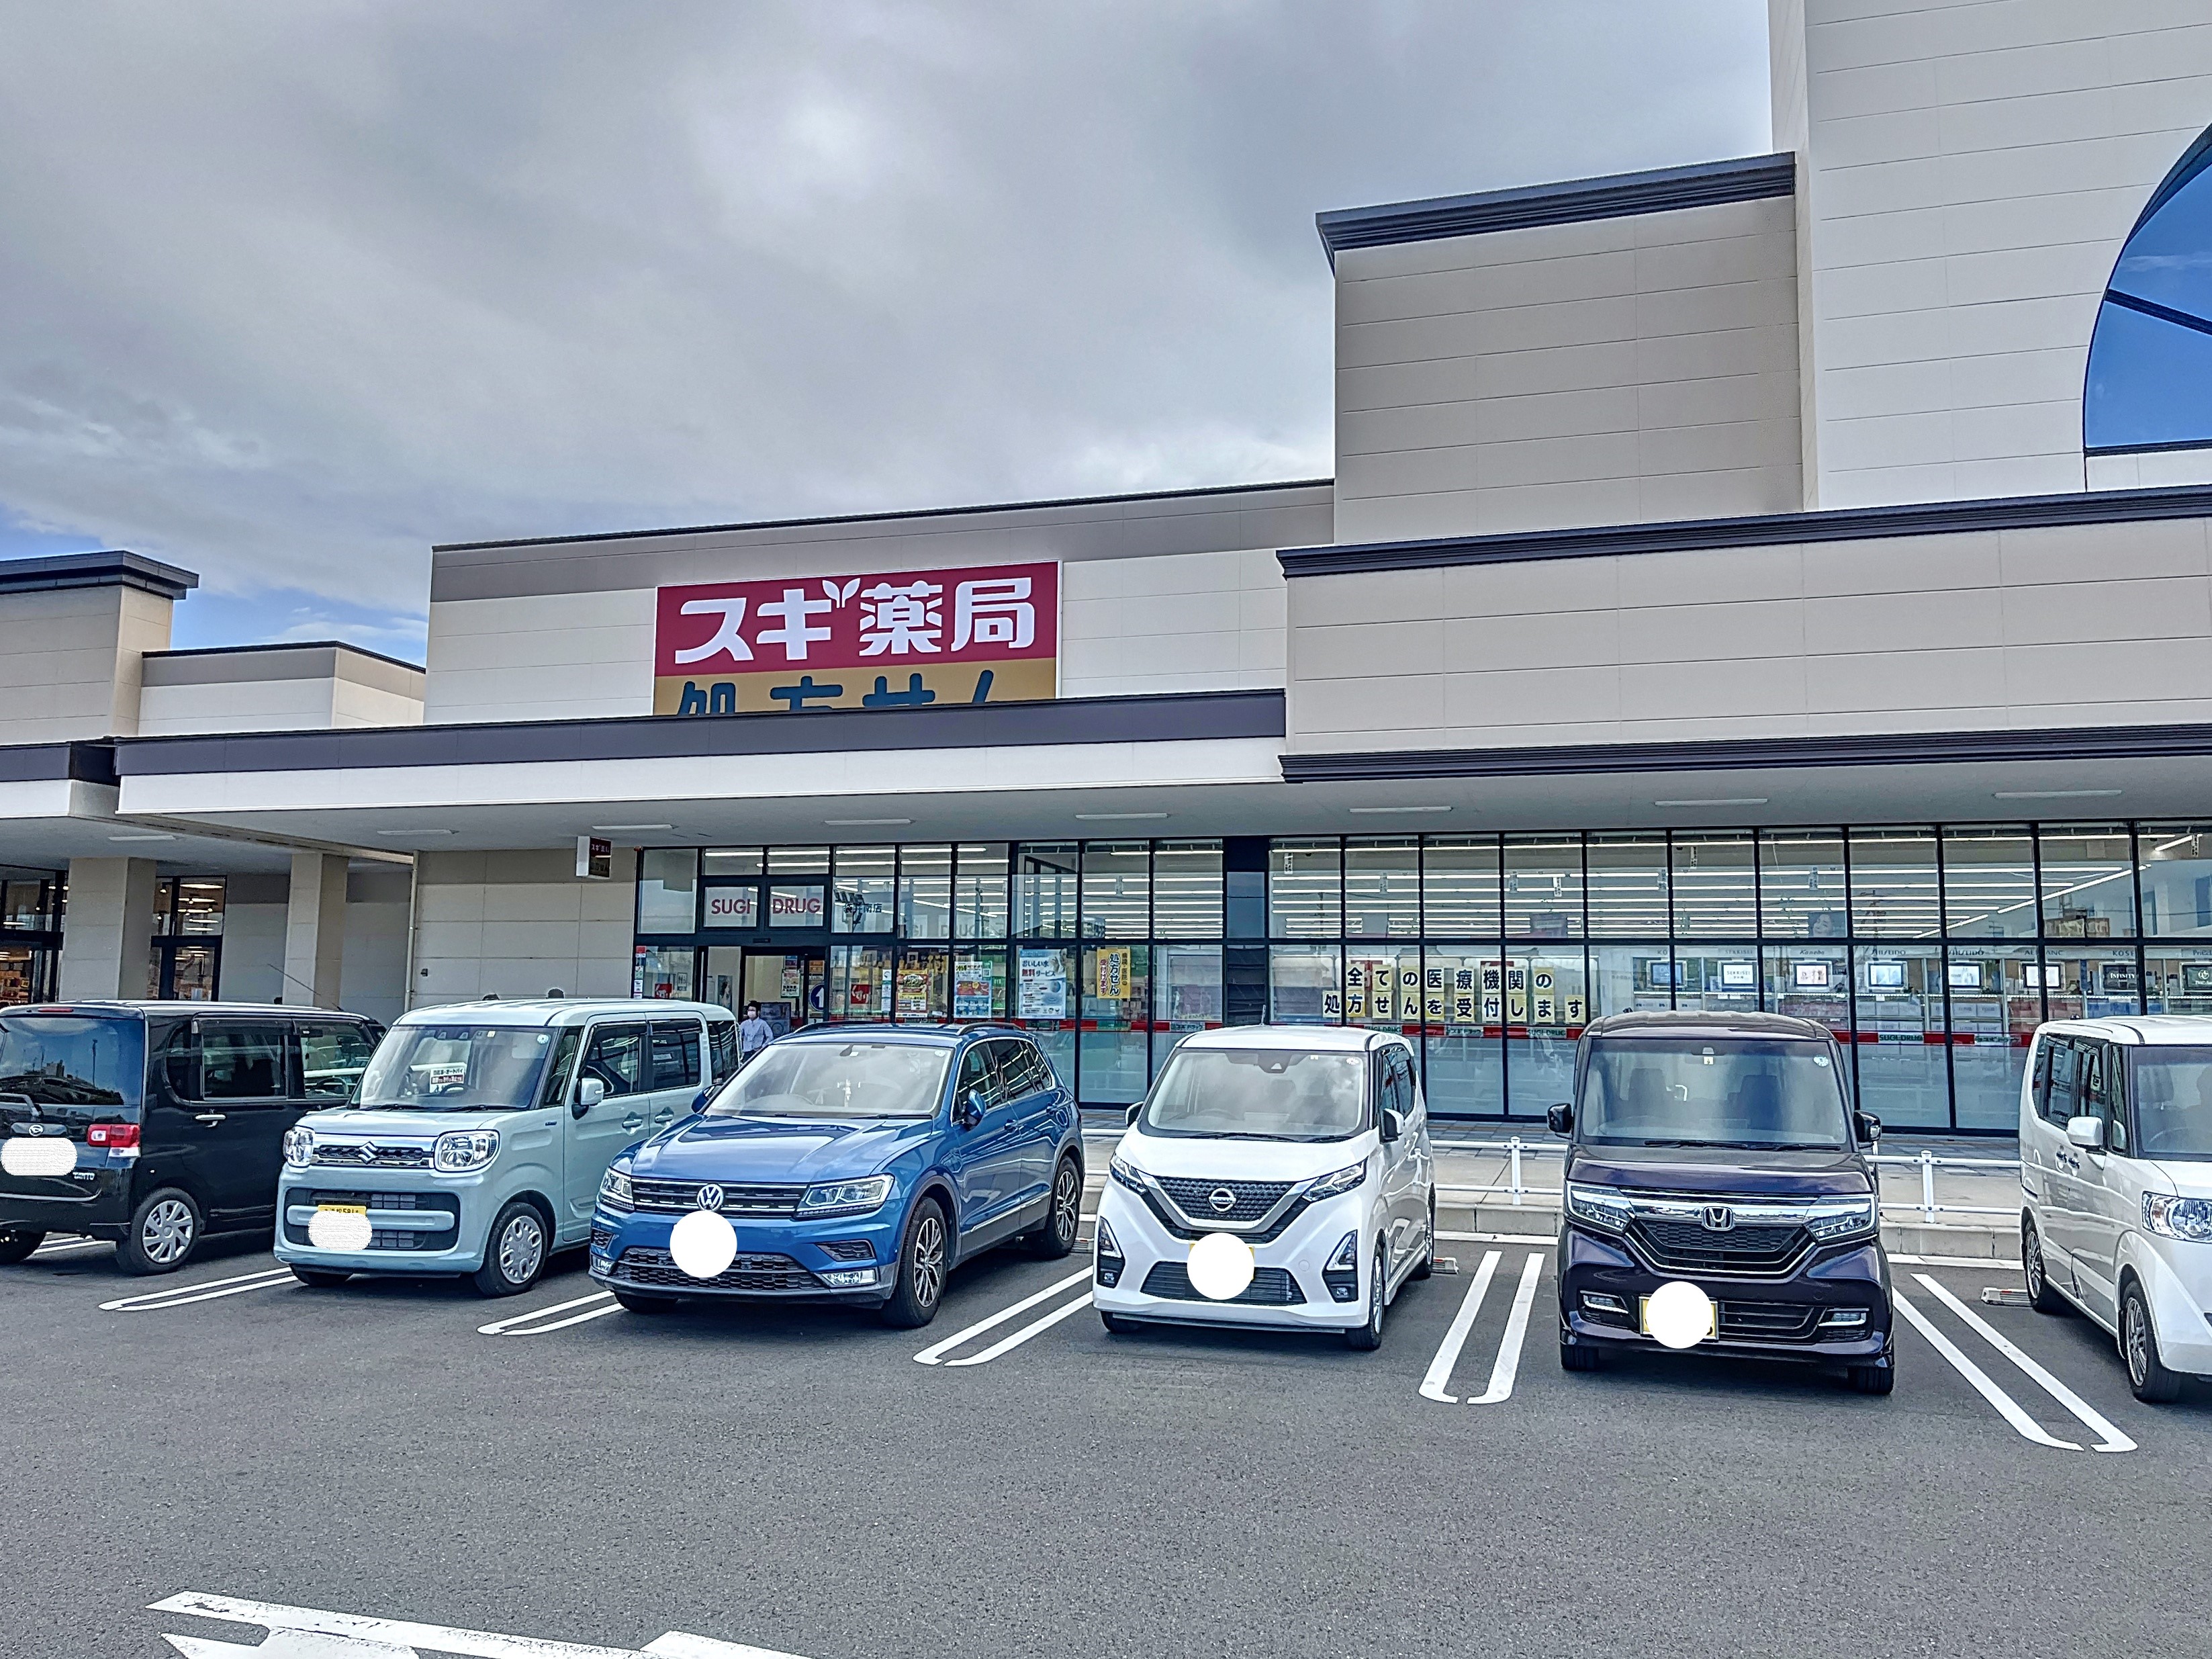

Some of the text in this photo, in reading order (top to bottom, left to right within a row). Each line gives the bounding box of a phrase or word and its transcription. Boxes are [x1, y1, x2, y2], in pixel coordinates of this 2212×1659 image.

[674, 577, 1035, 664] スギ薬局
[710, 898, 821, 915] SUGI DRUG
[1109, 953, 1119, 995] 処方せん
[1347, 967, 1553, 991] 全ての医療機関の
[1324, 993, 1583, 1018] 処方せんを受付します
